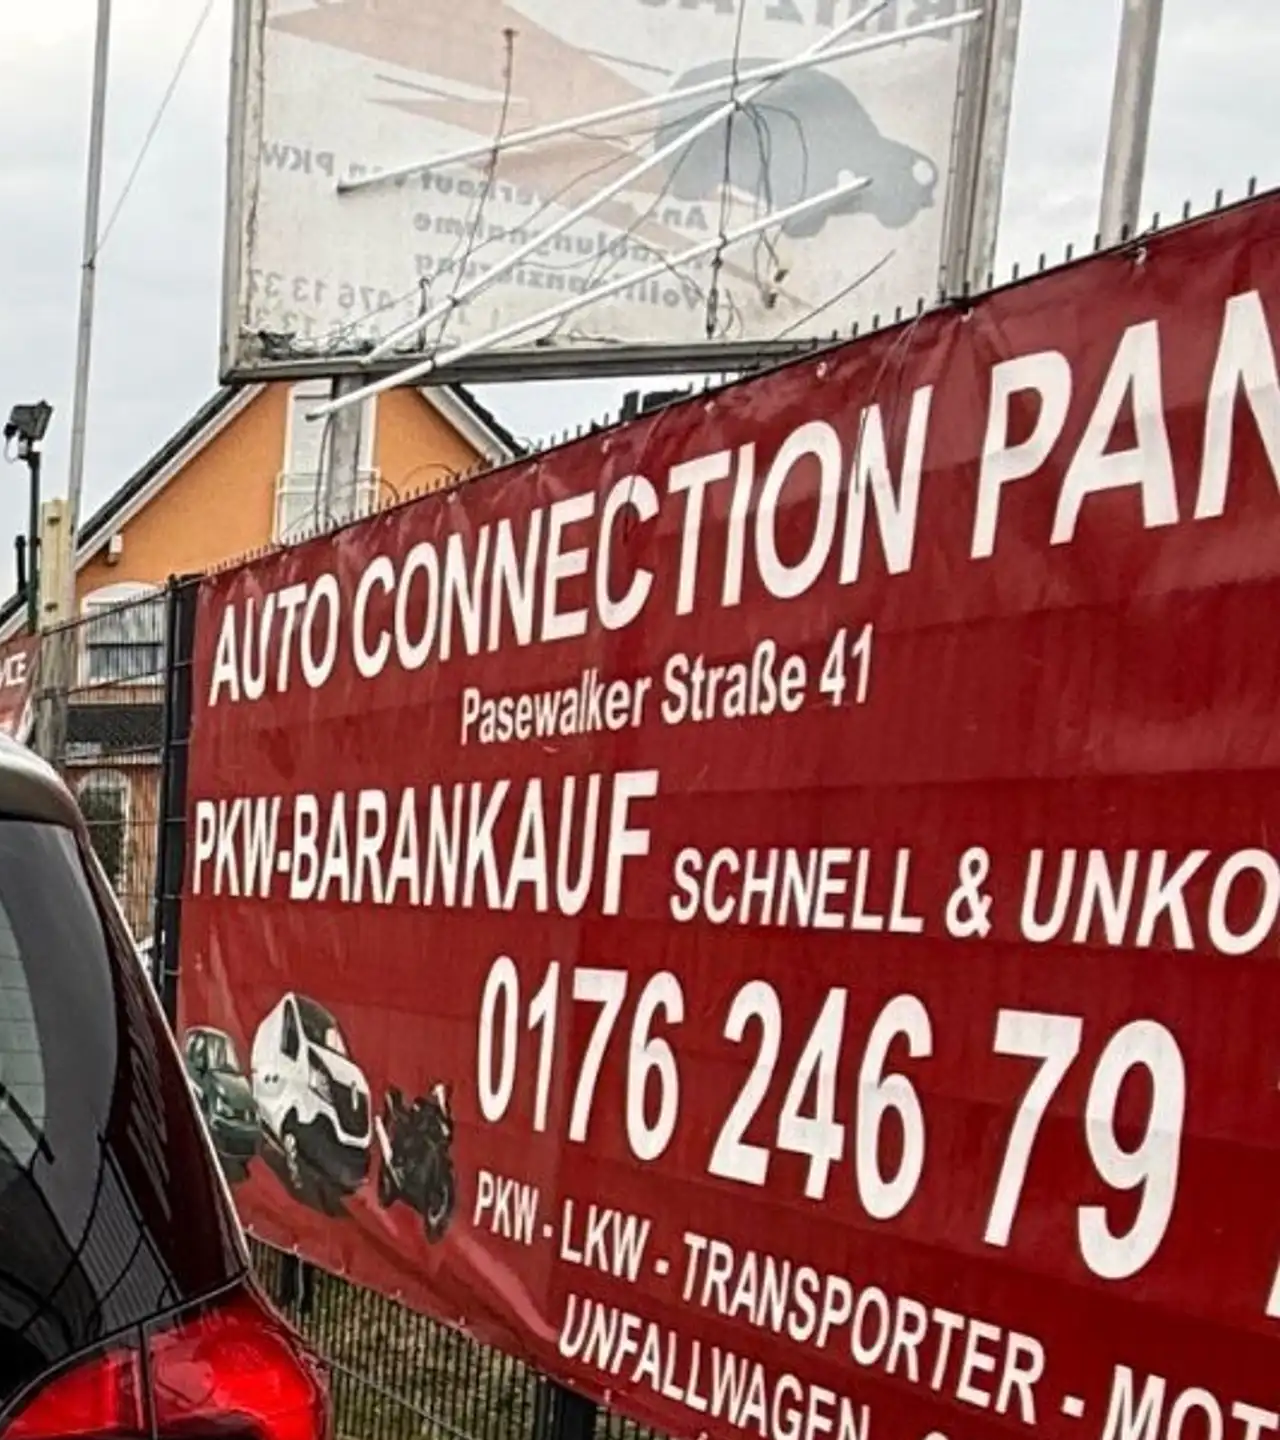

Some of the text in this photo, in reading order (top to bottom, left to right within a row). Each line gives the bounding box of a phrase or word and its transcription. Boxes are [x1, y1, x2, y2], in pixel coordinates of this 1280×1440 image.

[208, 573, 338, 705] AUTO
[352, 385, 934, 678] CONNECTION
[461, 623, 873, 745] Pasewalker Straße 41
[193, 770, 659, 917] PKW-BARANKAUF
[670, 847, 1280, 955] SCHNELL & UNKO
[479, 955, 684, 1161] 0176
[707, 980, 934, 1220] 246
[984, 1008, 1186, 1280] 79
[473, 1170, 538, 1245] PKW
[560, 1199, 651, 1282] LKW
[683, 1231, 1045, 1425] TRANSPORTER
